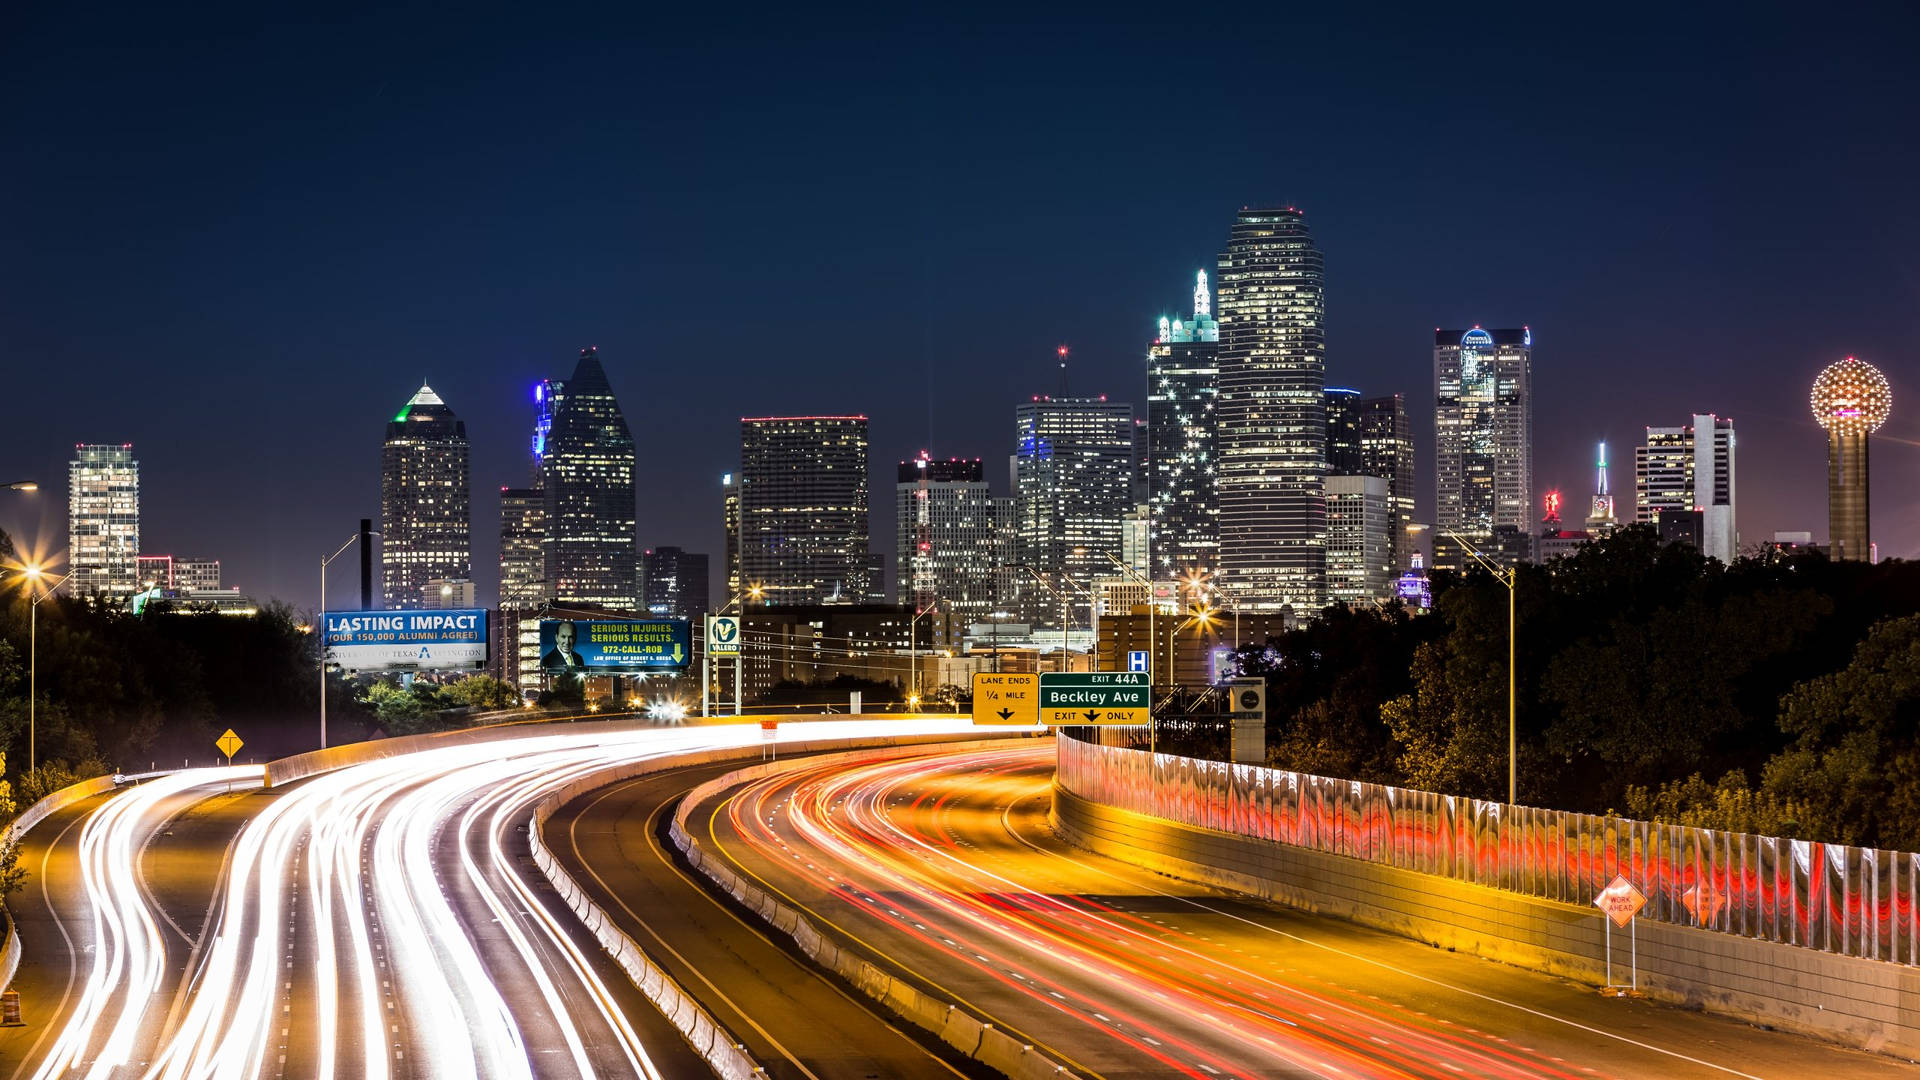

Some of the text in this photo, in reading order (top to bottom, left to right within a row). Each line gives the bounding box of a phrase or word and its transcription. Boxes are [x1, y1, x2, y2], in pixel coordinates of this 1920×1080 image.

[329, 615, 477, 632] LASTING IMPACT
[591, 624, 674, 633] SERIOUS INJURIES.
[329, 631, 478, 642] (OUR 150,000 ALUMNI AGREE)
[591, 634, 674, 642] SERIOUS RESULTS.
[602, 645, 663, 654] 972-CALL-ROB
[712, 644, 737, 652] VALERO
[392, 650, 418, 658] TEXAS
[1130, 652, 1146, 671] H
[981, 677, 1031, 685] LANE ENDS
[1091, 674, 1139, 684] EXIT 44A
[1005, 691, 1025, 699] MILE
[1050, 691, 1139, 705] Beckley Ave
[1054, 712, 1135, 720] EXIT ONLY
[1608, 904, 1633, 912] AHEAD
